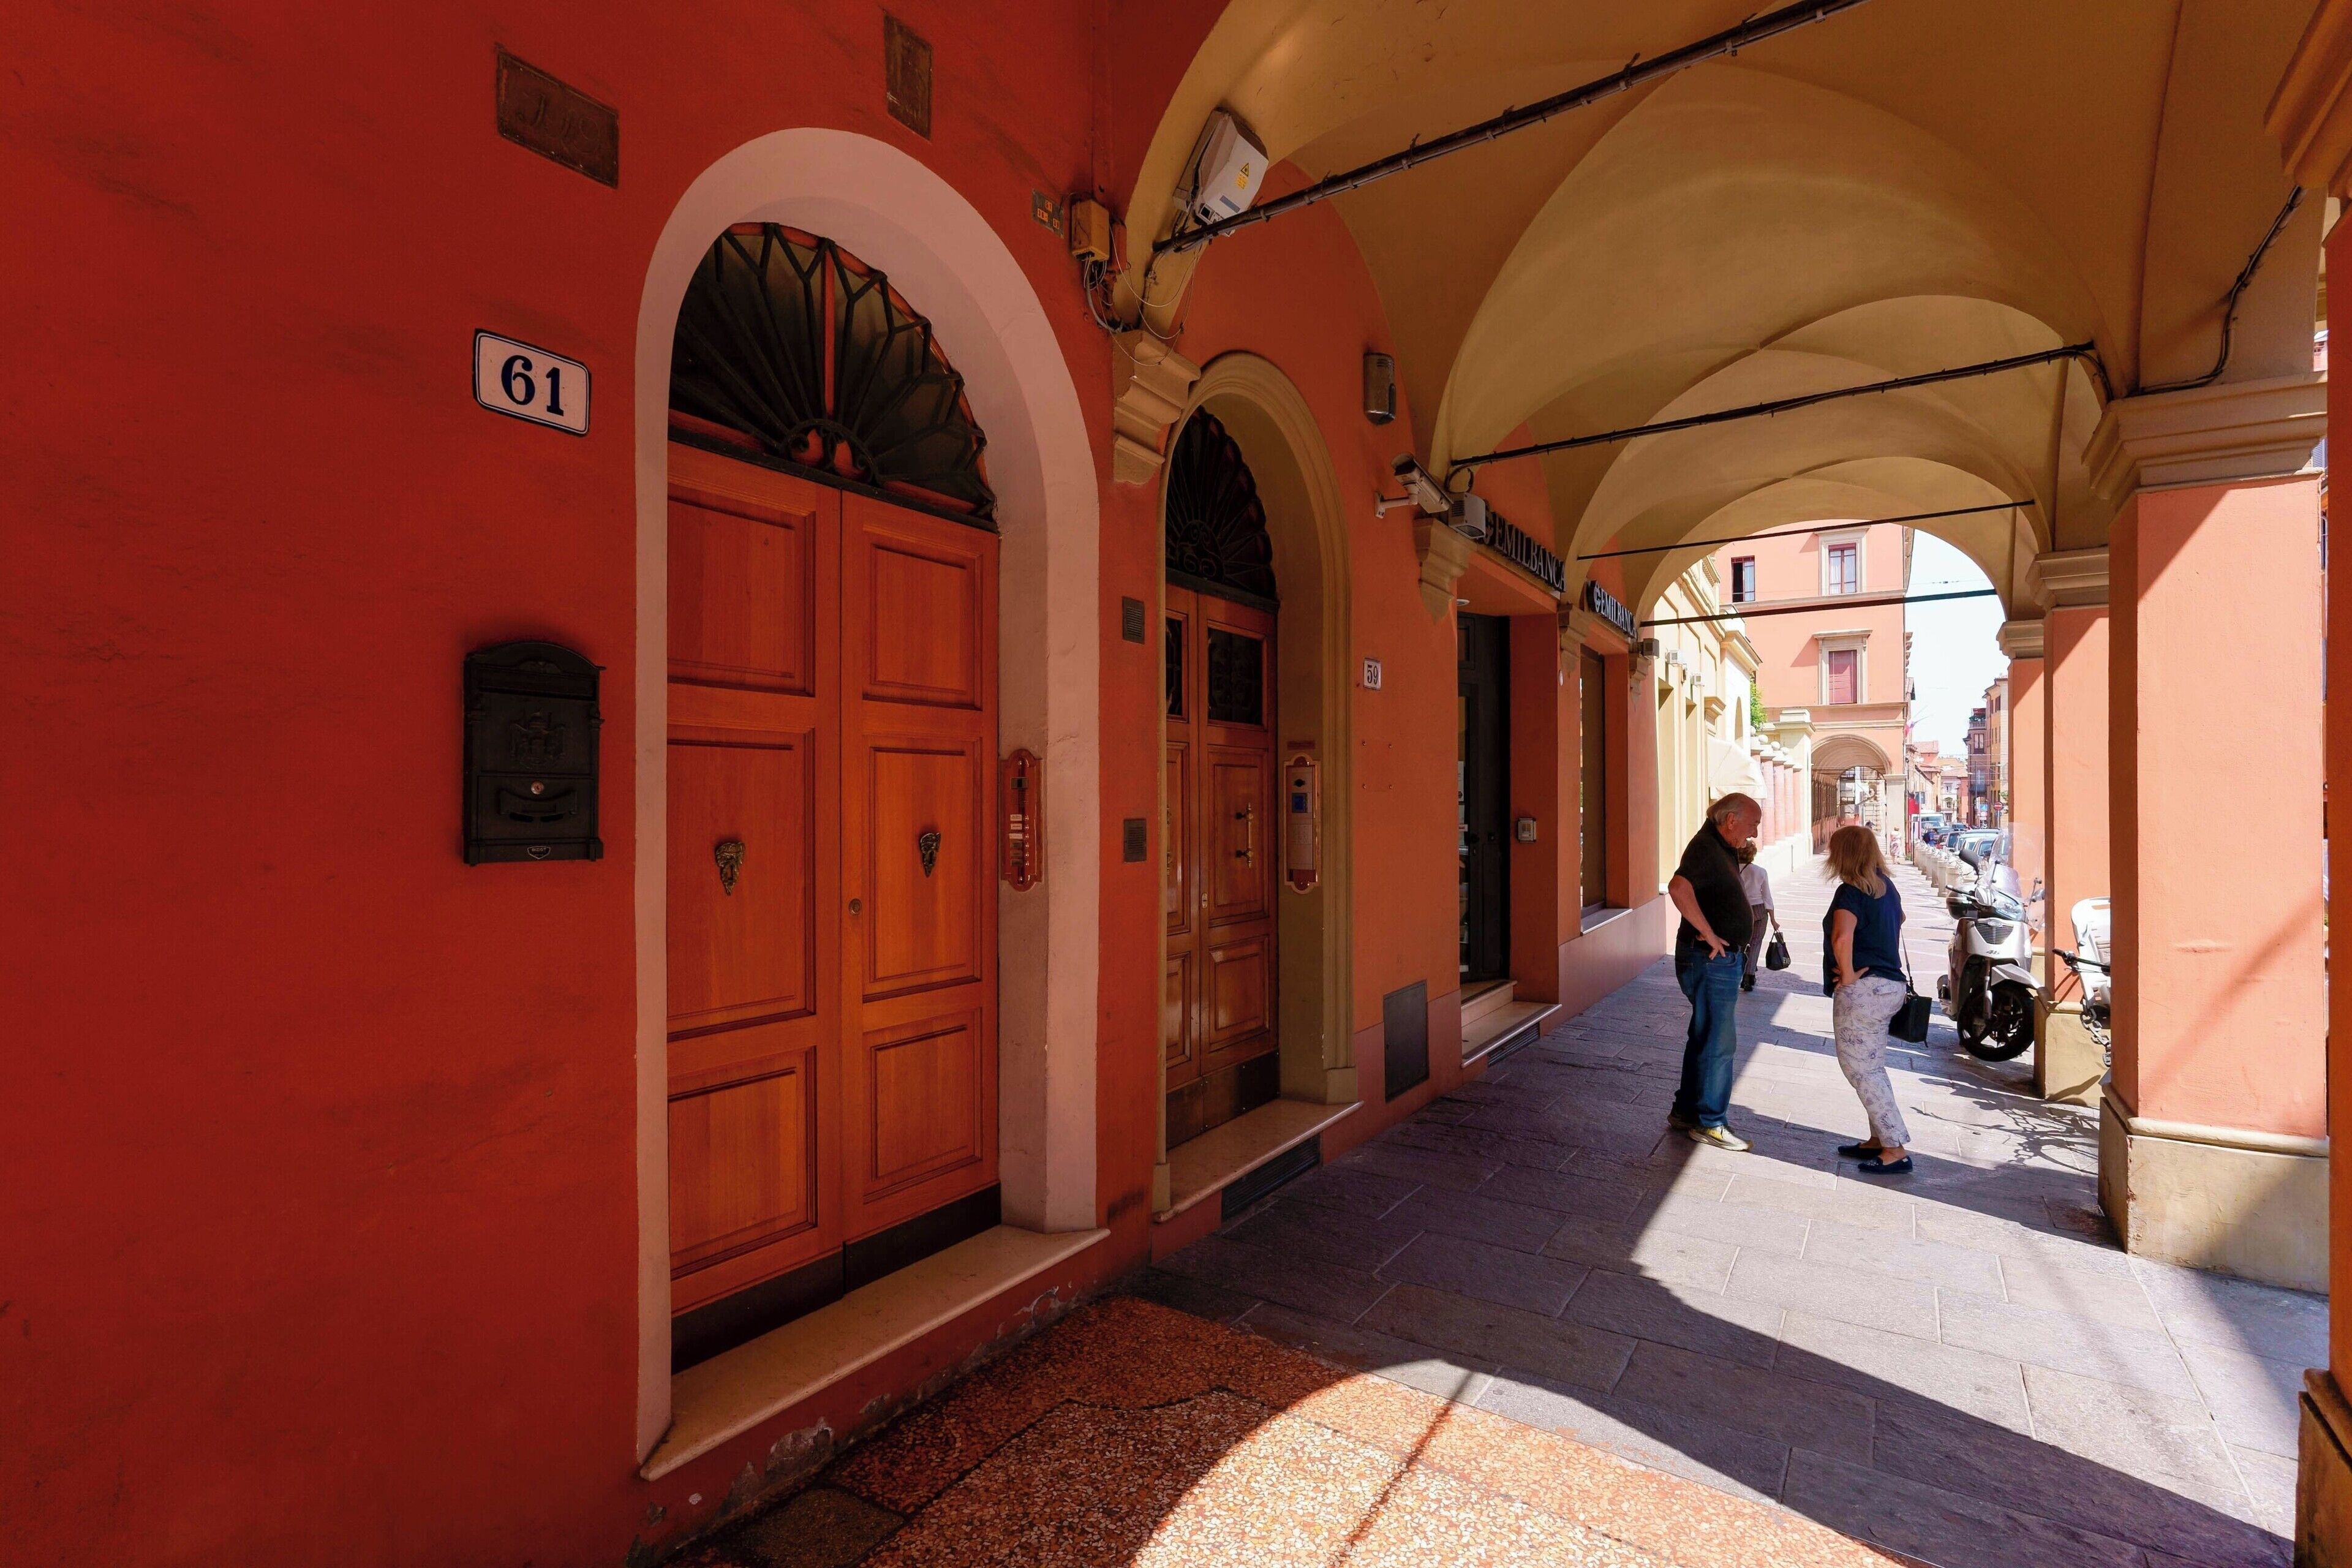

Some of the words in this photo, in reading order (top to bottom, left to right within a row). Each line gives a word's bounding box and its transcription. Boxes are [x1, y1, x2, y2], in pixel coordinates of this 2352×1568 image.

[500, 355, 565, 417] 61
[1494, 513, 1566, 592] EMILBANCA
[1601, 588, 1637, 639] EMILBANCA
[1366, 664, 1378, 685] 59
